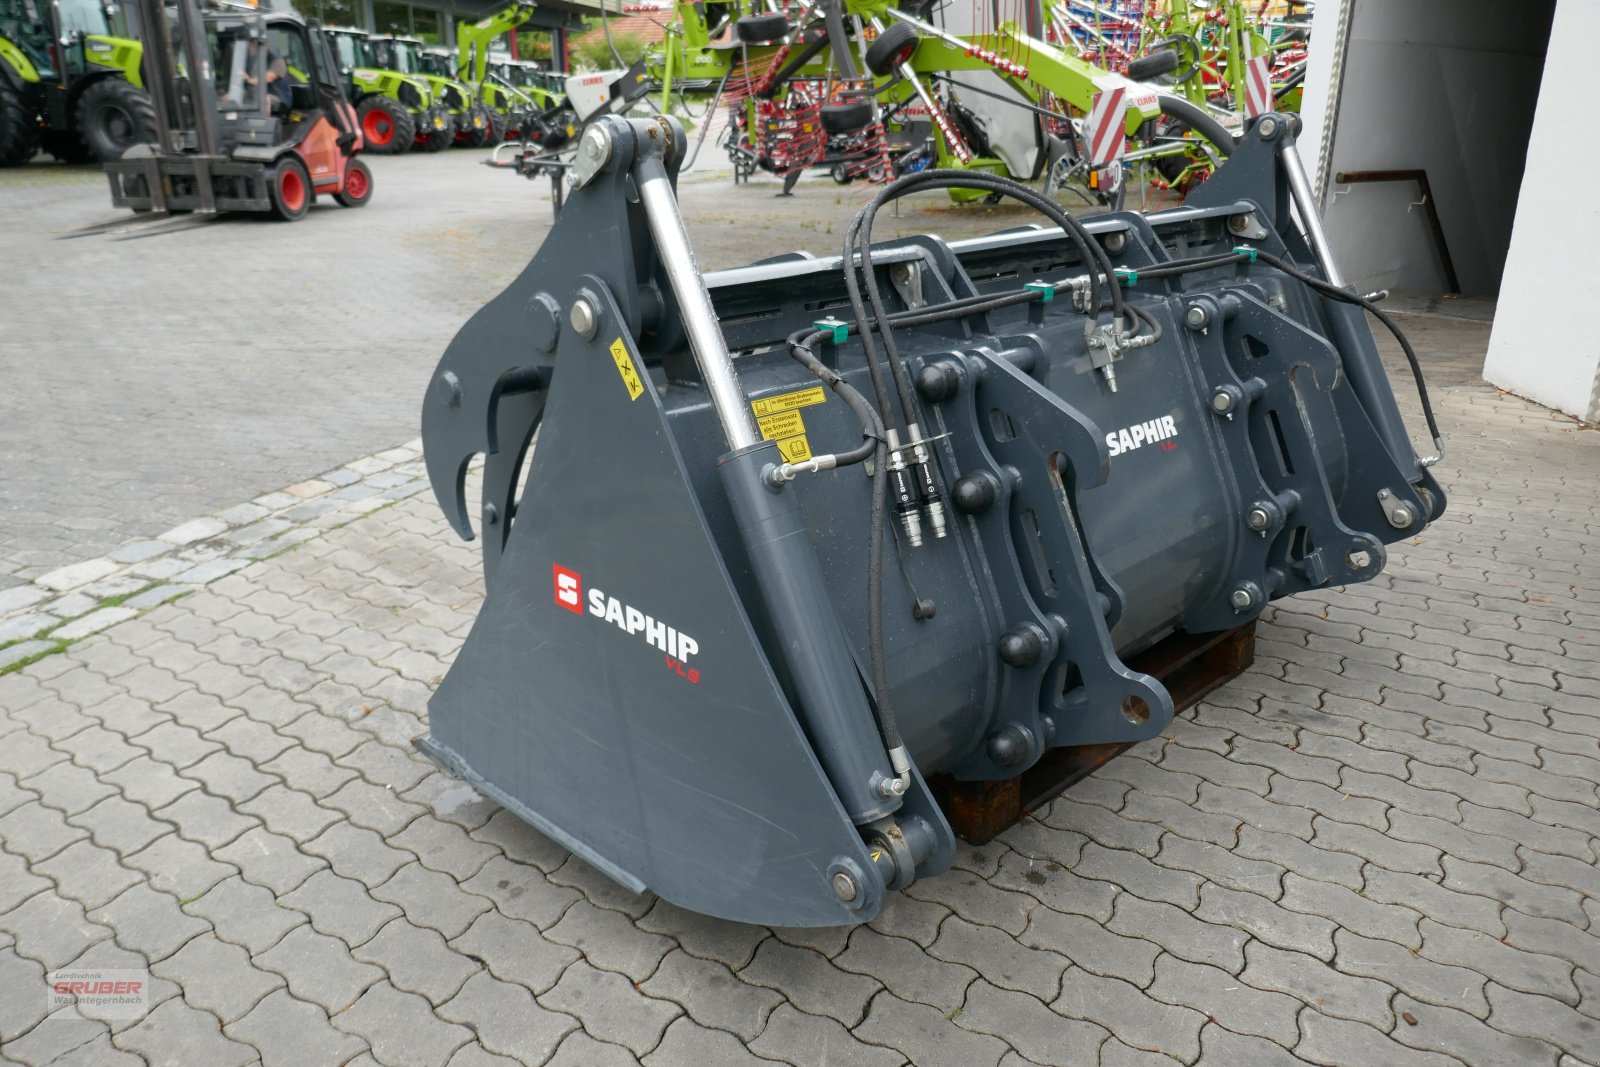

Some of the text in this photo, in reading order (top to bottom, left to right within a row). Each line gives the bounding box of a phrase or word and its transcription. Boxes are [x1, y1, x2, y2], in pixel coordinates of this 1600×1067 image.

[1137, 96, 1157, 106] CLAAS
[772, 413, 797, 424] Ersteinsatz
[773, 420, 798, 430] Schrauben
[1106, 415, 1178, 457] SAPHIR
